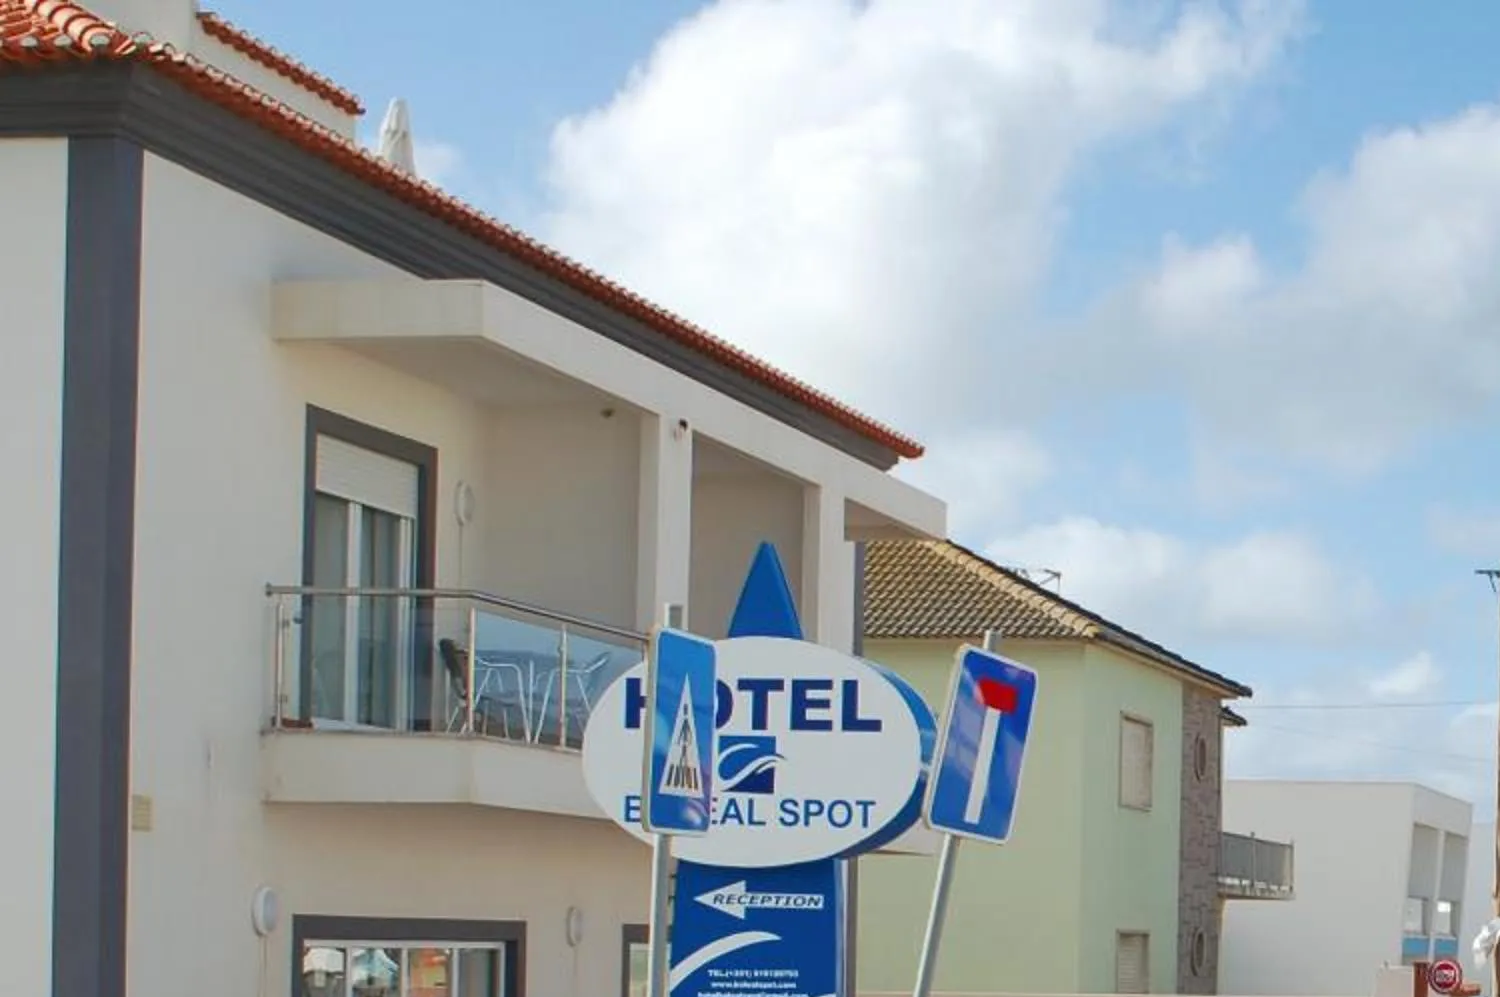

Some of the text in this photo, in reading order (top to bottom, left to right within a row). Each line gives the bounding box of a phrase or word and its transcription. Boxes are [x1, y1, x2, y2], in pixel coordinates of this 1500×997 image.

[624, 795, 876, 828] BAL SPOT
[713, 893, 821, 907] RECEPTION
